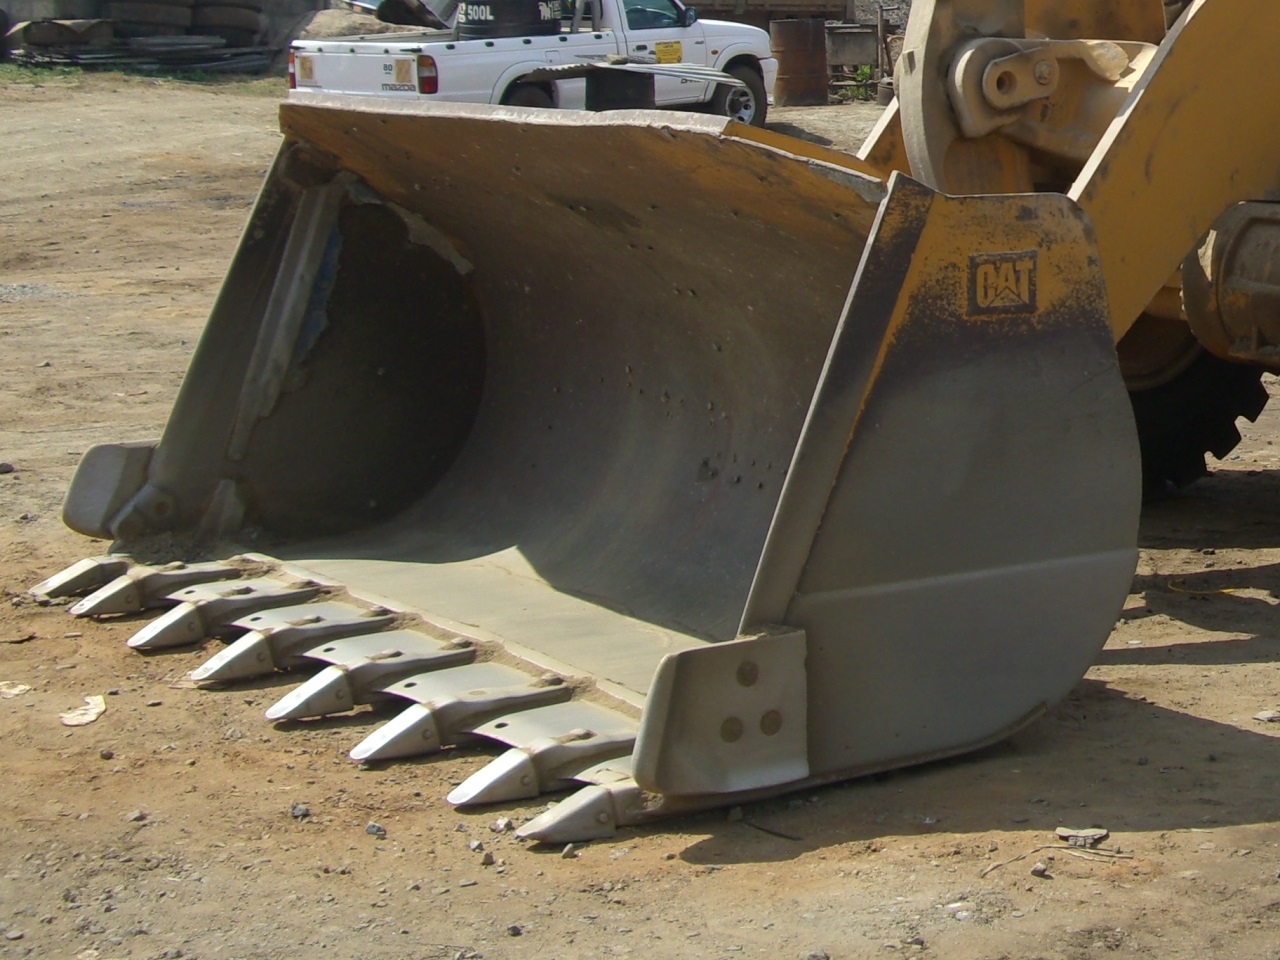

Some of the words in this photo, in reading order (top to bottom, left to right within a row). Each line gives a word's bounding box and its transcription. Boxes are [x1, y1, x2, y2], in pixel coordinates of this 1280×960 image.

[467, 5, 494, 20] 500L
[383, 63, 393, 71] 80
[975, 259, 1034, 308] CAT
